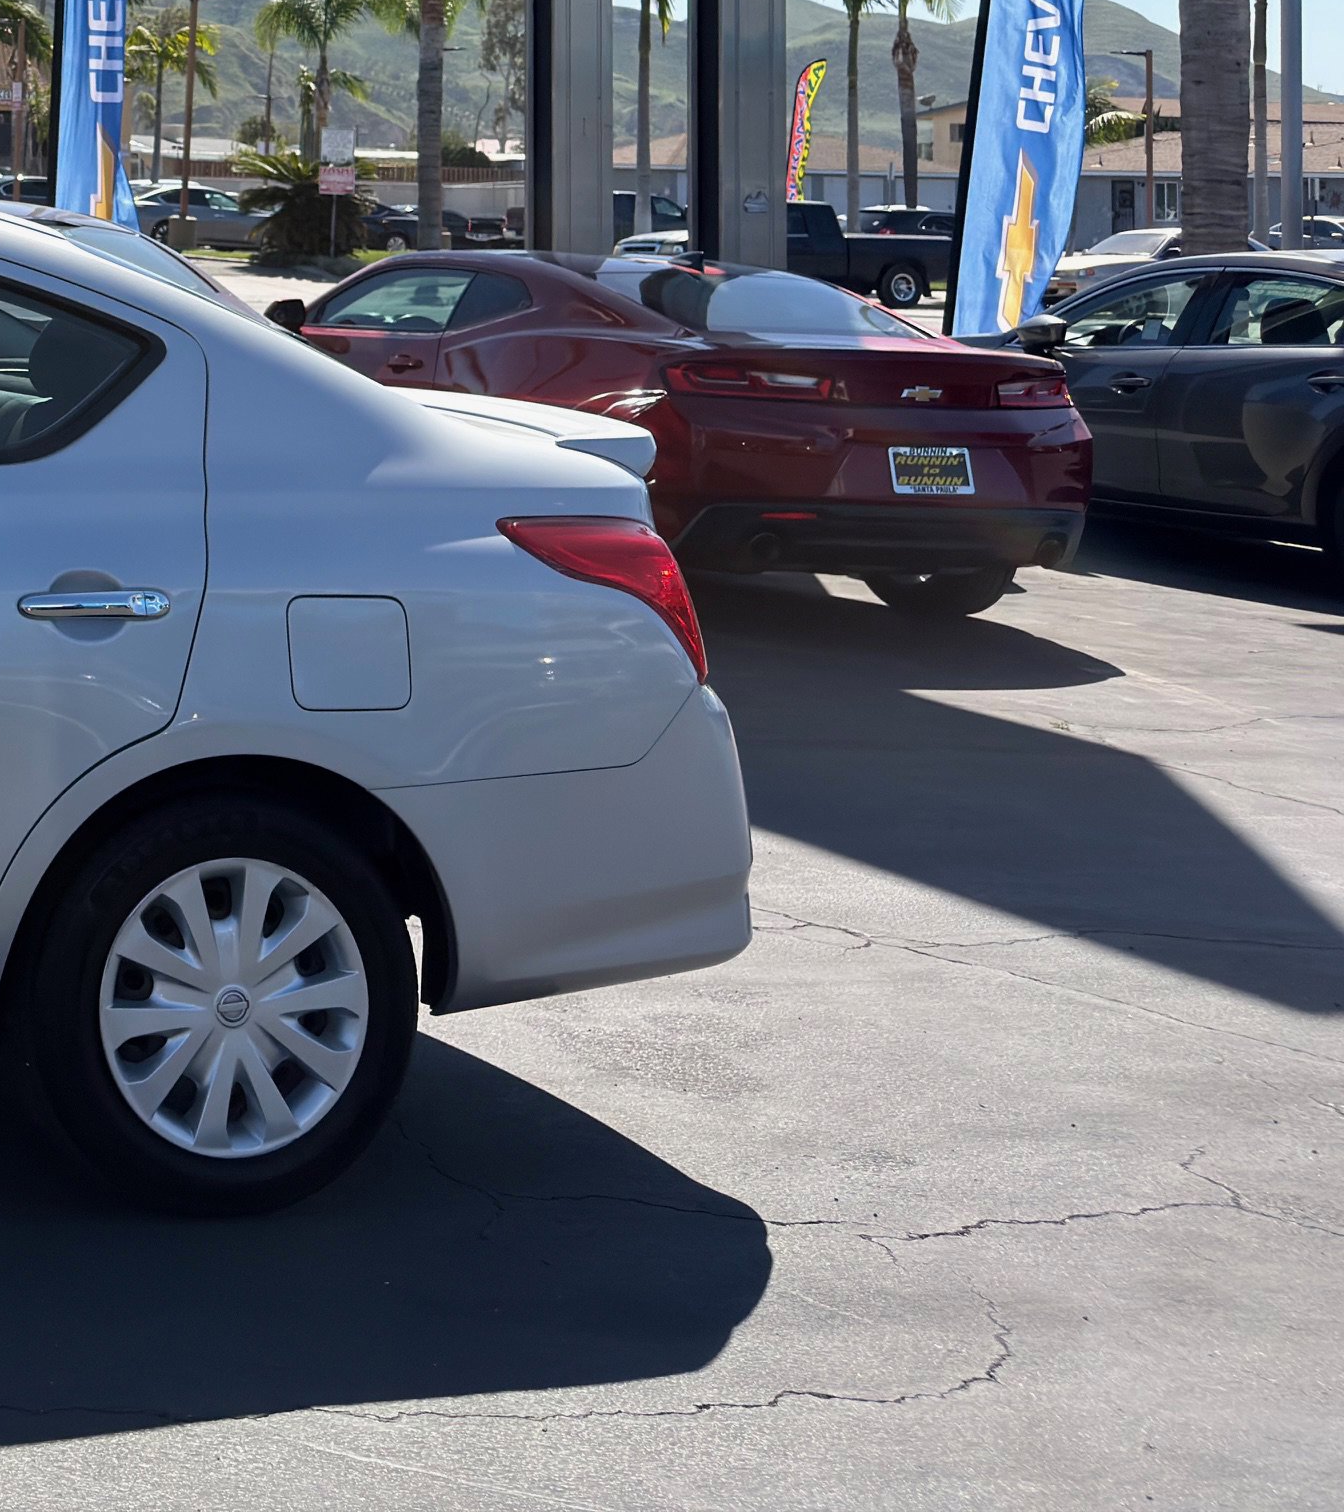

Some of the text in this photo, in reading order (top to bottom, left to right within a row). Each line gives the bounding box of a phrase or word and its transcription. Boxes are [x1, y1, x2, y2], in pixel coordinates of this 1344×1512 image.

[909, 447, 948, 456] BUNNIN
[895, 455, 964, 466] RUNNIN'
[898, 476, 964, 485] BUNNIN
